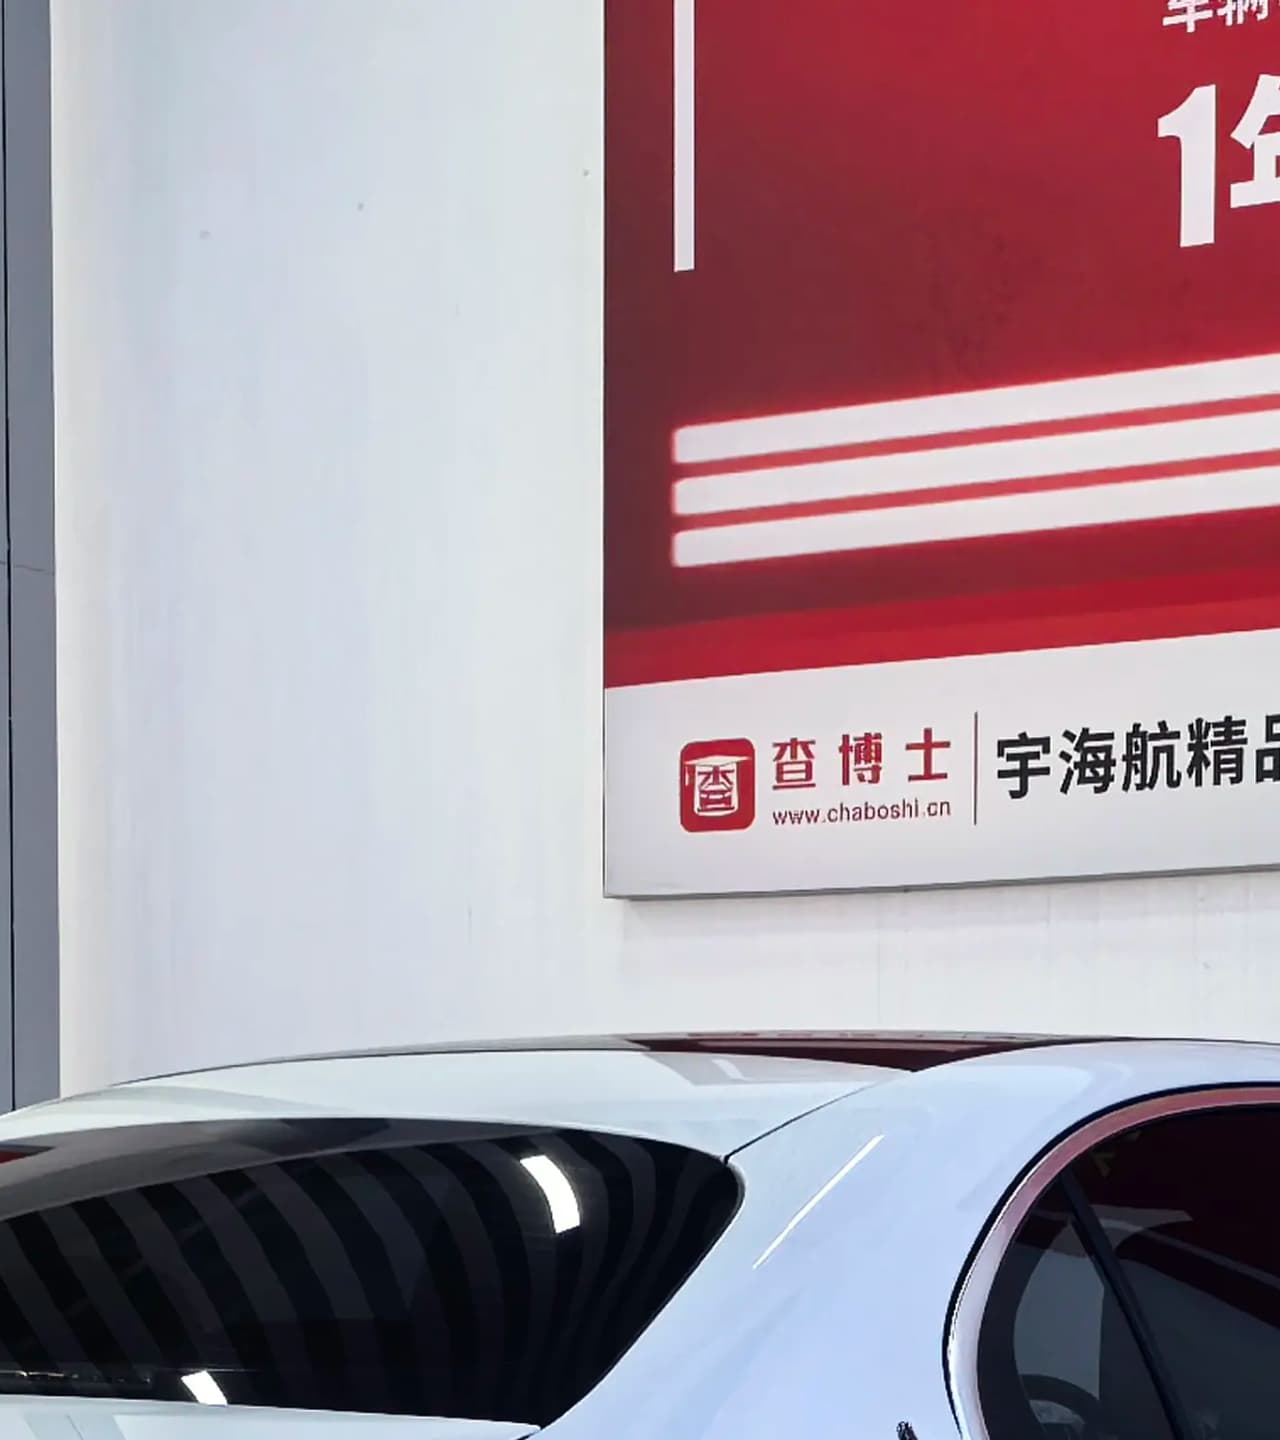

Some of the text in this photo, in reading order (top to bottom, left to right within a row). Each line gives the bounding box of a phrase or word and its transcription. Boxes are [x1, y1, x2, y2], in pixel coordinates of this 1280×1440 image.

[771, 727, 951, 791] 查博士
[772, 797, 952, 826] www.chaboshi.cn
